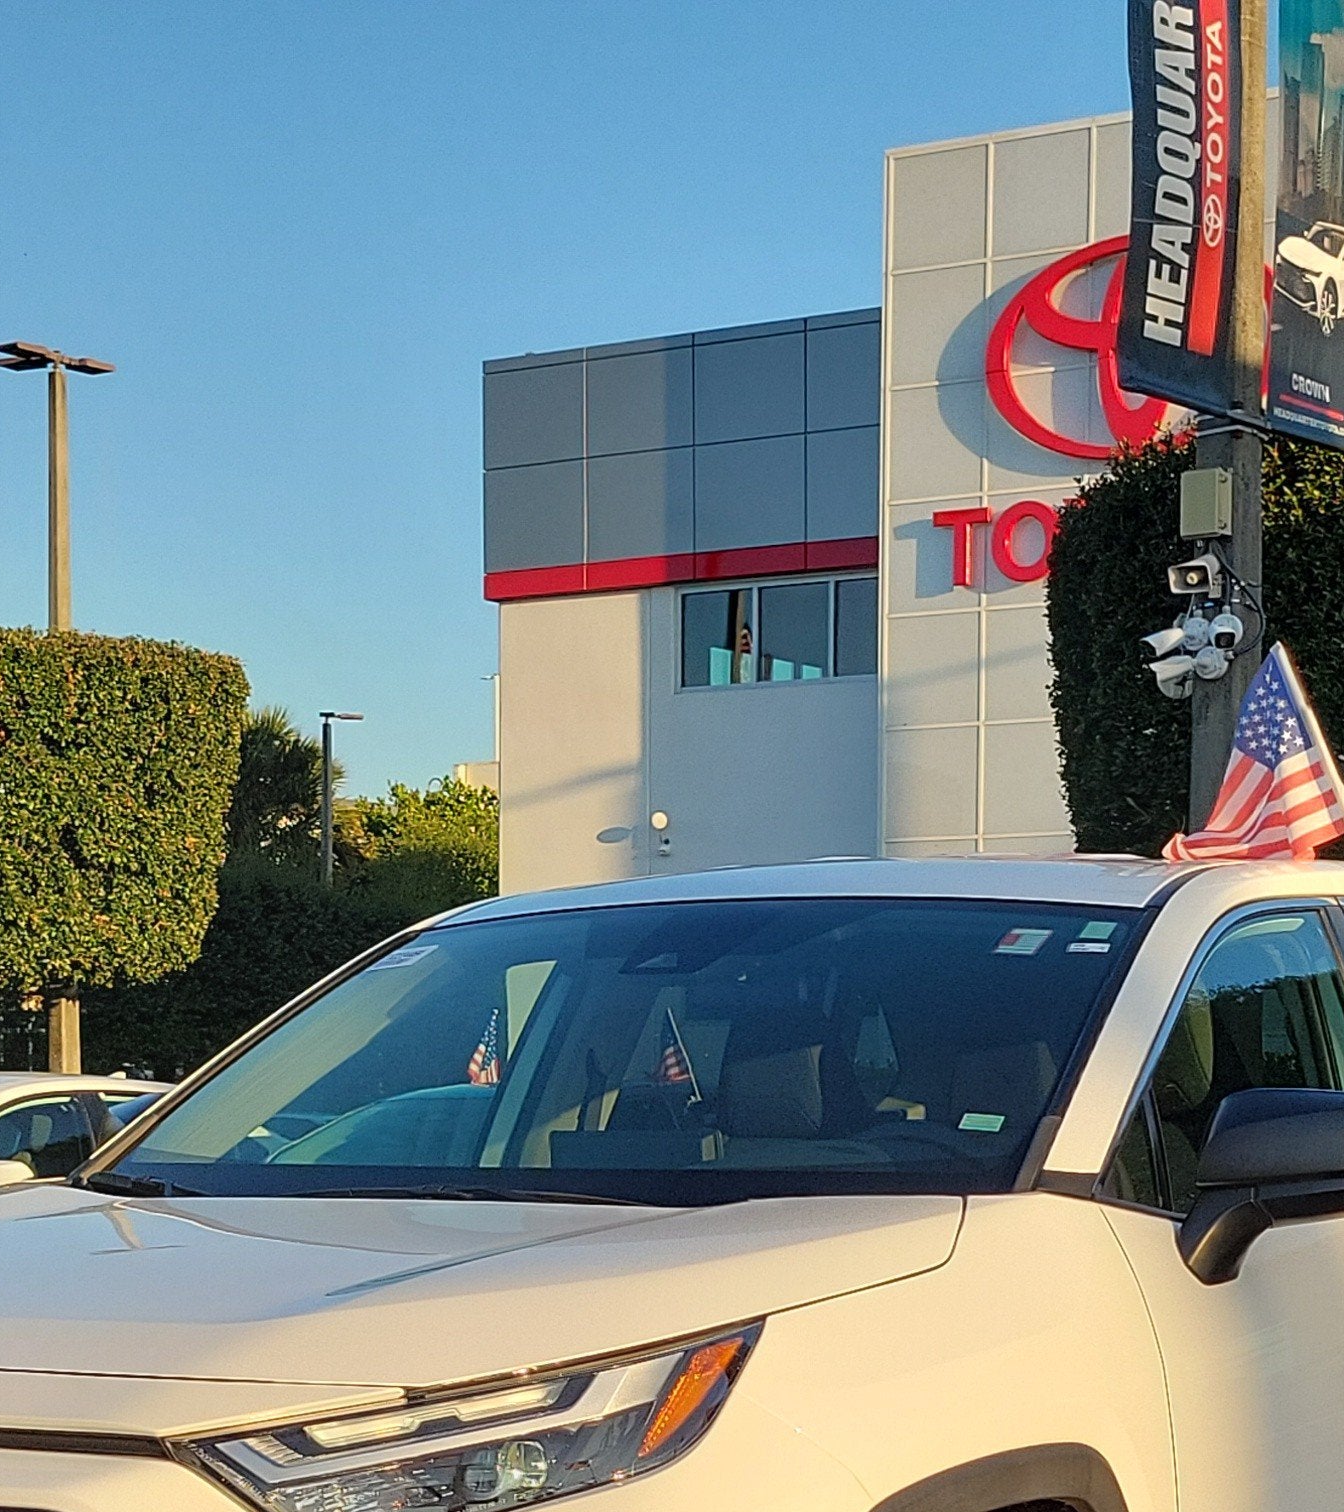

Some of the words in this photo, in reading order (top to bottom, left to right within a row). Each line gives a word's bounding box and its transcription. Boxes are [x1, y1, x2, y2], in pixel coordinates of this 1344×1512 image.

[1205, 21, 1224, 188] TOYOTA
[1291, 373, 1331, 403] CROWN
[933, 500, 1061, 587] TO
